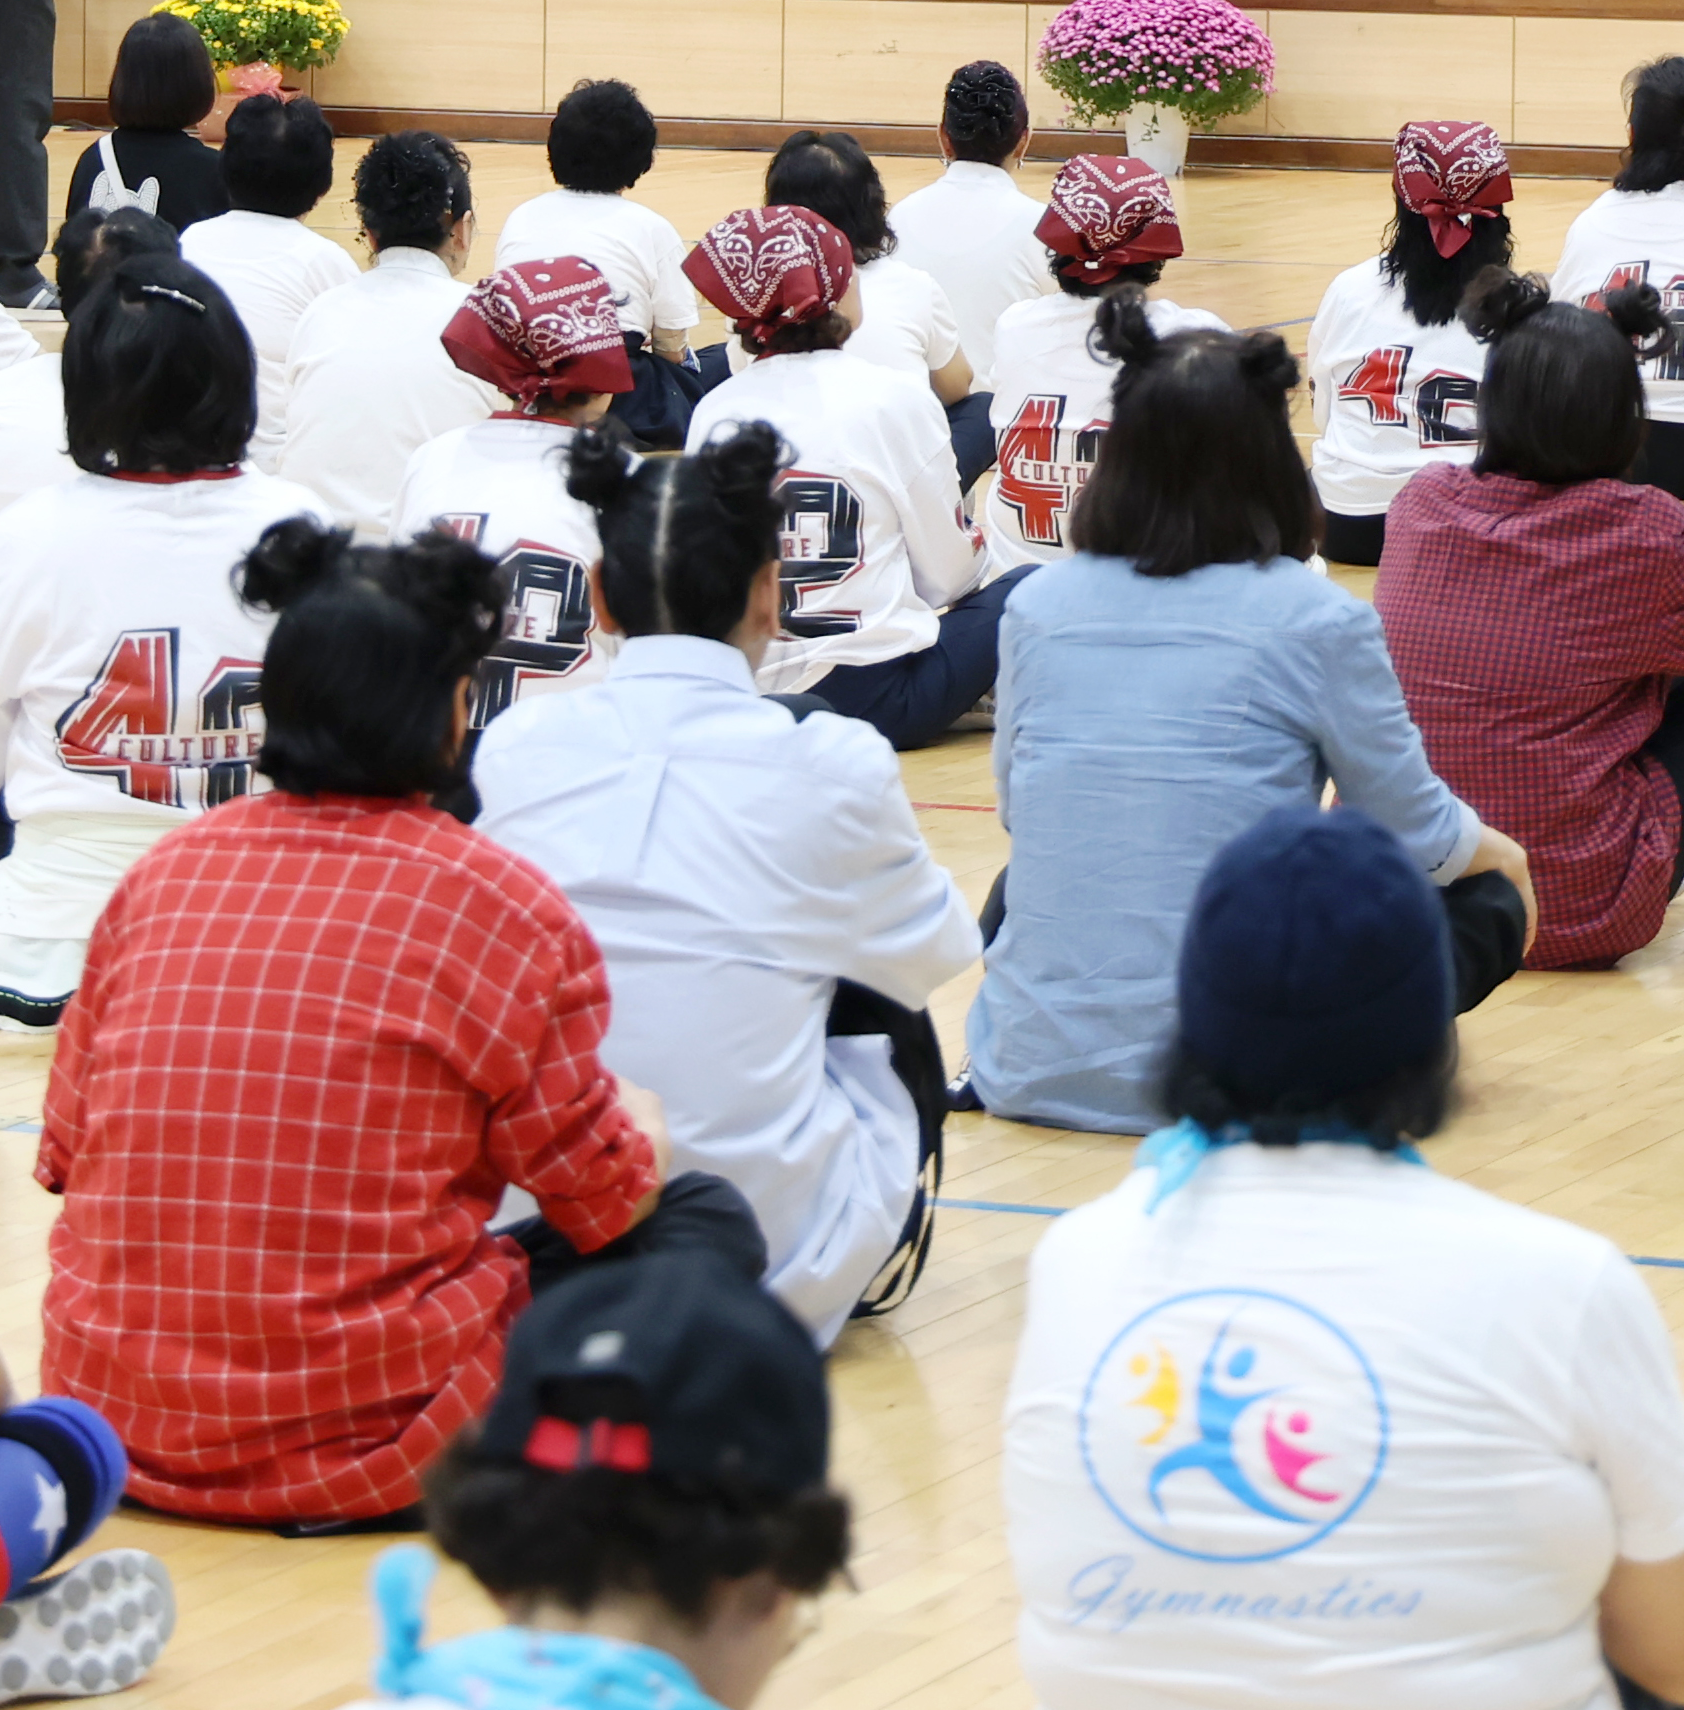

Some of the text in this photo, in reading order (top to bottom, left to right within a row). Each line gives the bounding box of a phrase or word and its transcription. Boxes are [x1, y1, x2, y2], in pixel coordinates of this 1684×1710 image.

[1020, 461, 1089, 485] CULTU
[118, 737, 262, 762] CULTURE
[1063, 1554, 1425, 1635] Gymnastics
